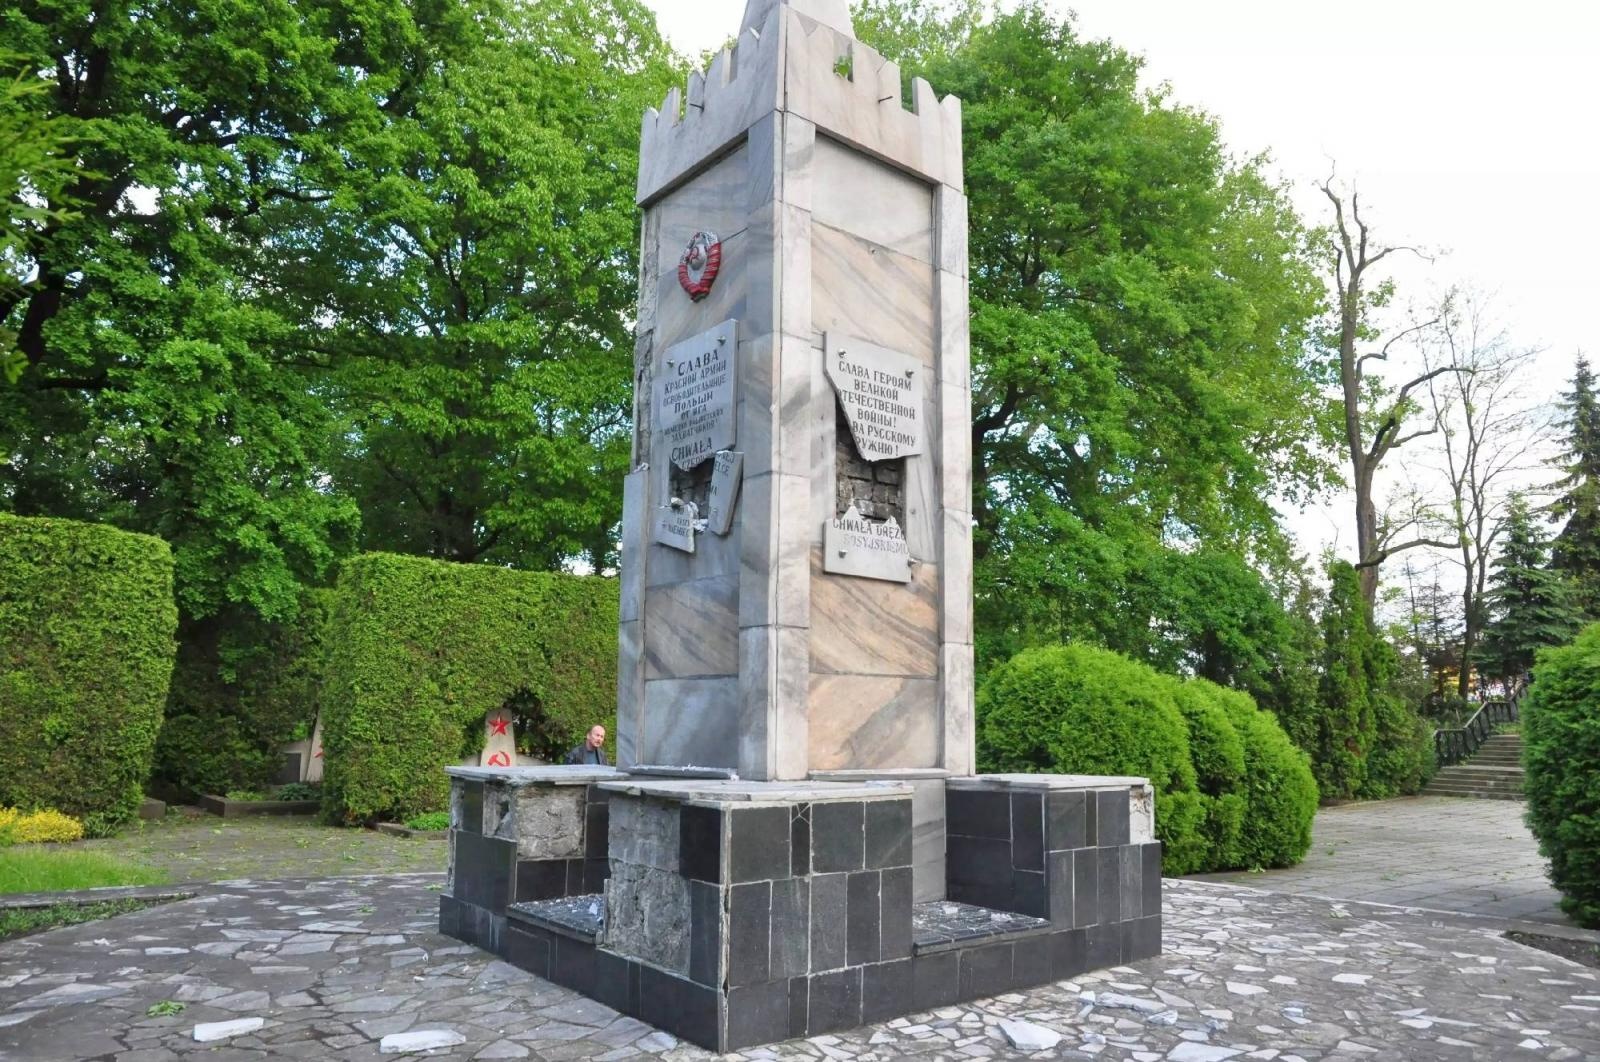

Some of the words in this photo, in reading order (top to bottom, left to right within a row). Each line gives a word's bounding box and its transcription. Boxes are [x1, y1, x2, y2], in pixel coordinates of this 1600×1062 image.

[678, 349, 718, 376] СЛАВА
[664, 372, 697, 395] КРАСНОЙ
[701, 359, 726, 380] АРМИИ
[838, 360, 870, 380] СЛАВА
[874, 370, 911, 391] ГЕРОЯМ
[854, 378, 898, 401] ВЕЛИКОЙ
[675, 391, 713, 413] ПОЛЬШИ
[681, 410, 690, 420] ОТ
[857, 408, 897, 428] ВОЙНЫ!
[867, 425, 916, 447] РУССКОМУ
[671, 437, 713, 462] CHWAŁA
